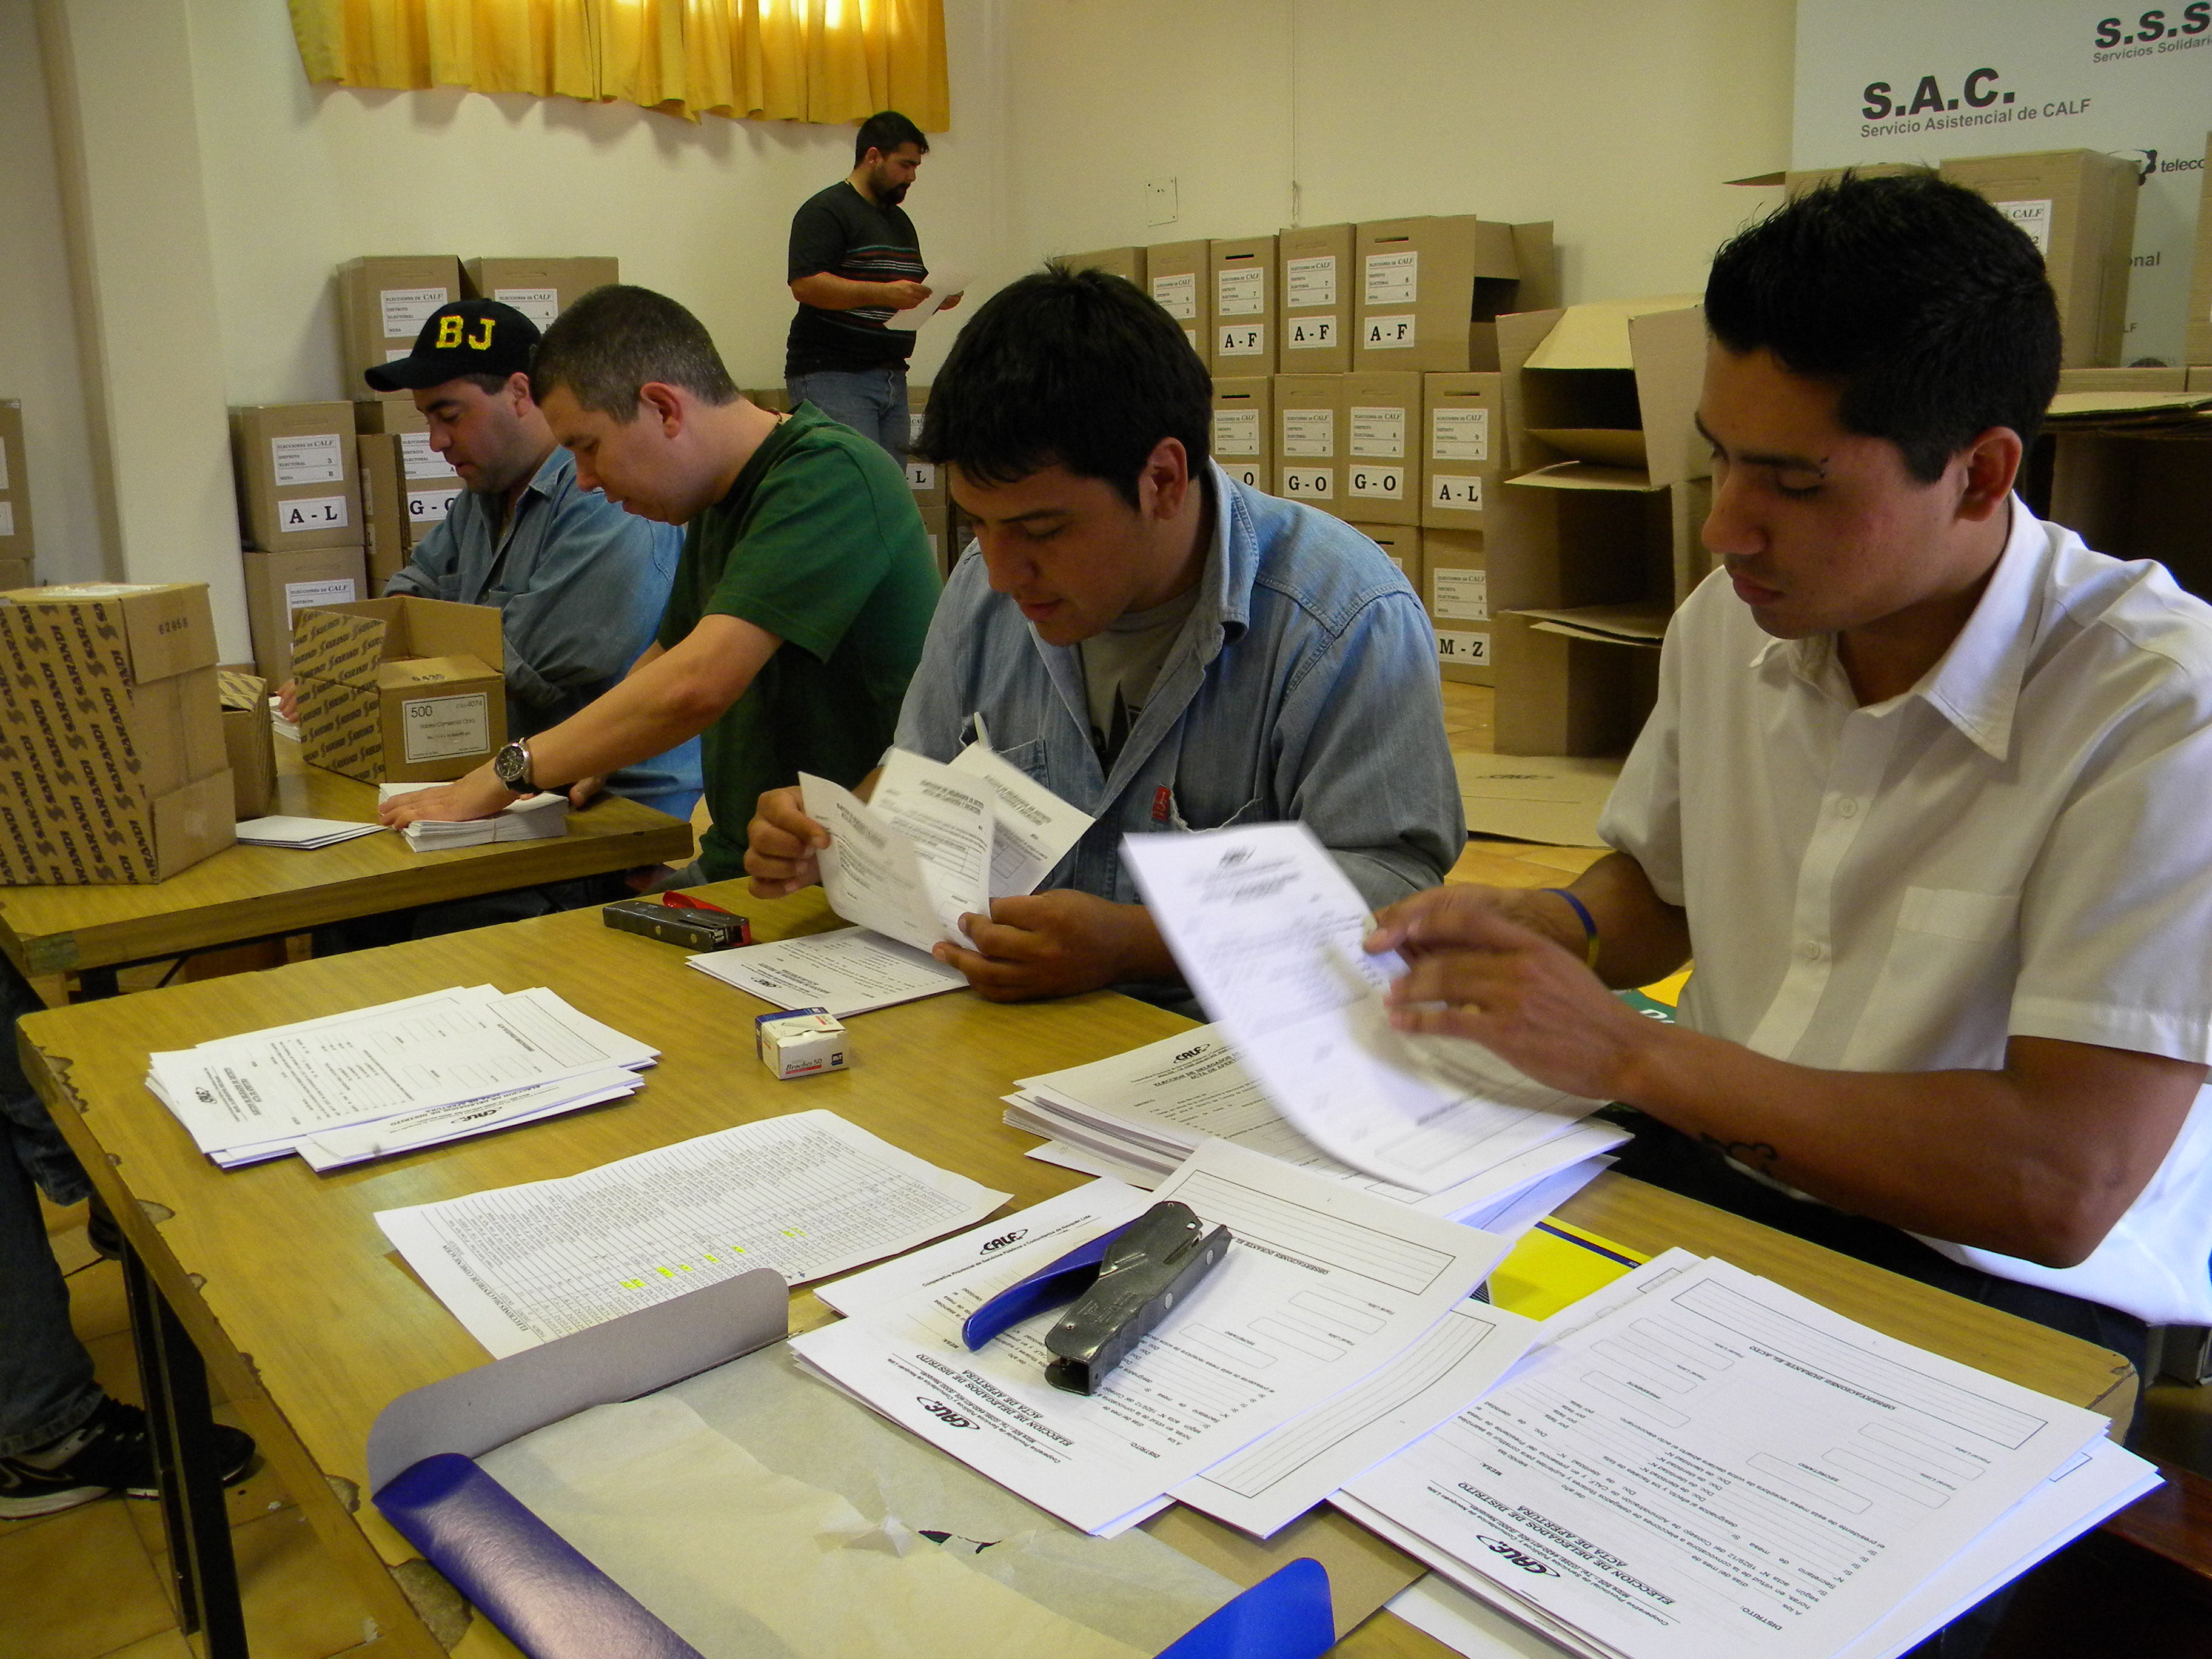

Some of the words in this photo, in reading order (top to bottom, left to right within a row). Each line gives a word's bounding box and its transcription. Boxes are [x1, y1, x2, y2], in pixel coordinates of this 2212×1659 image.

[2093, 46, 2153, 64] Servicios
[2157, 38, 2212, 53] Solidari
[1862, 67, 2015, 120] S.A.C.
[1861, 122, 1921, 138] Servicio
[1925, 109, 2011, 130] Asistencial
[2017, 106, 2037, 121] de
[2043, 99, 2091, 118] CALF
[2013, 209, 2043, 218] CALF
[1225, 333, 1235, 348] A
[1248, 332, 1257, 347] F
[1295, 326, 1305, 341] A
[1319, 324, 1330, 340] F
[1370, 326, 1381, 341] A
[1397, 324, 1407, 340] F
[916, 471, 927, 483] L
[1244, 472, 1254, 486] O
[1289, 475, 1300, 491] G
[1315, 477, 1327, 491] O
[1355, 474, 1367, 489] G
[1383, 475, 1396, 491] O
[1439, 484, 1451, 500] A
[1468, 486, 1478, 502] L
[289, 509, 304, 524] A
[324, 506, 338, 520] L
[410, 500, 424, 515] G
[1439, 638, 1455, 655] M
[1472, 641, 1483, 657] Z
[411, 706, 433, 718] 500
[1176, 1047, 1202, 1061] CALF
[786, 1060, 813, 1071] Broches
[983, 1232, 1021, 1251] CALF
[1749, 1346, 1774, 1357] ACTO
[916, 1354, 954, 1376] DISTRITO
[1784, 1361, 1825, 1381] DURANTE
[951, 1375, 967, 1384] DE
[962, 1370, 1007, 1398] APERTURA
[965, 1383, 1017, 1415] DELEGADOS
[1003, 1396, 1020, 1406] DE
[1824, 1379, 1896, 1410] OBSERVACIONES
[925, 1401, 974, 1428] CALF
[1013, 1413, 1031, 1423] DE
[1017, 1404, 1043, 1419] ACTA
[1027, 1421, 1073, 1446] ELECCION
[1480, 1462, 1503, 1476] MESA:
[1798, 1463, 1840, 1483] SECRETARIO
[1458, 1483, 1509, 1512] DISTRITO
[1507, 1512, 1526, 1522] DE
[1517, 1506, 1574, 1538] APERTURA
[1526, 1522, 1594, 1560] DELEGADOS
[1574, 1539, 1592, 1550] DE
[1487, 1540, 1549, 1574] CALF
[1593, 1560, 1612, 1571] DE
[1594, 1549, 1626, 1567] ACTA
[1611, 1570, 1674, 1605] ELECCION
[1740, 1606, 1783, 1631] DISTRITO:
